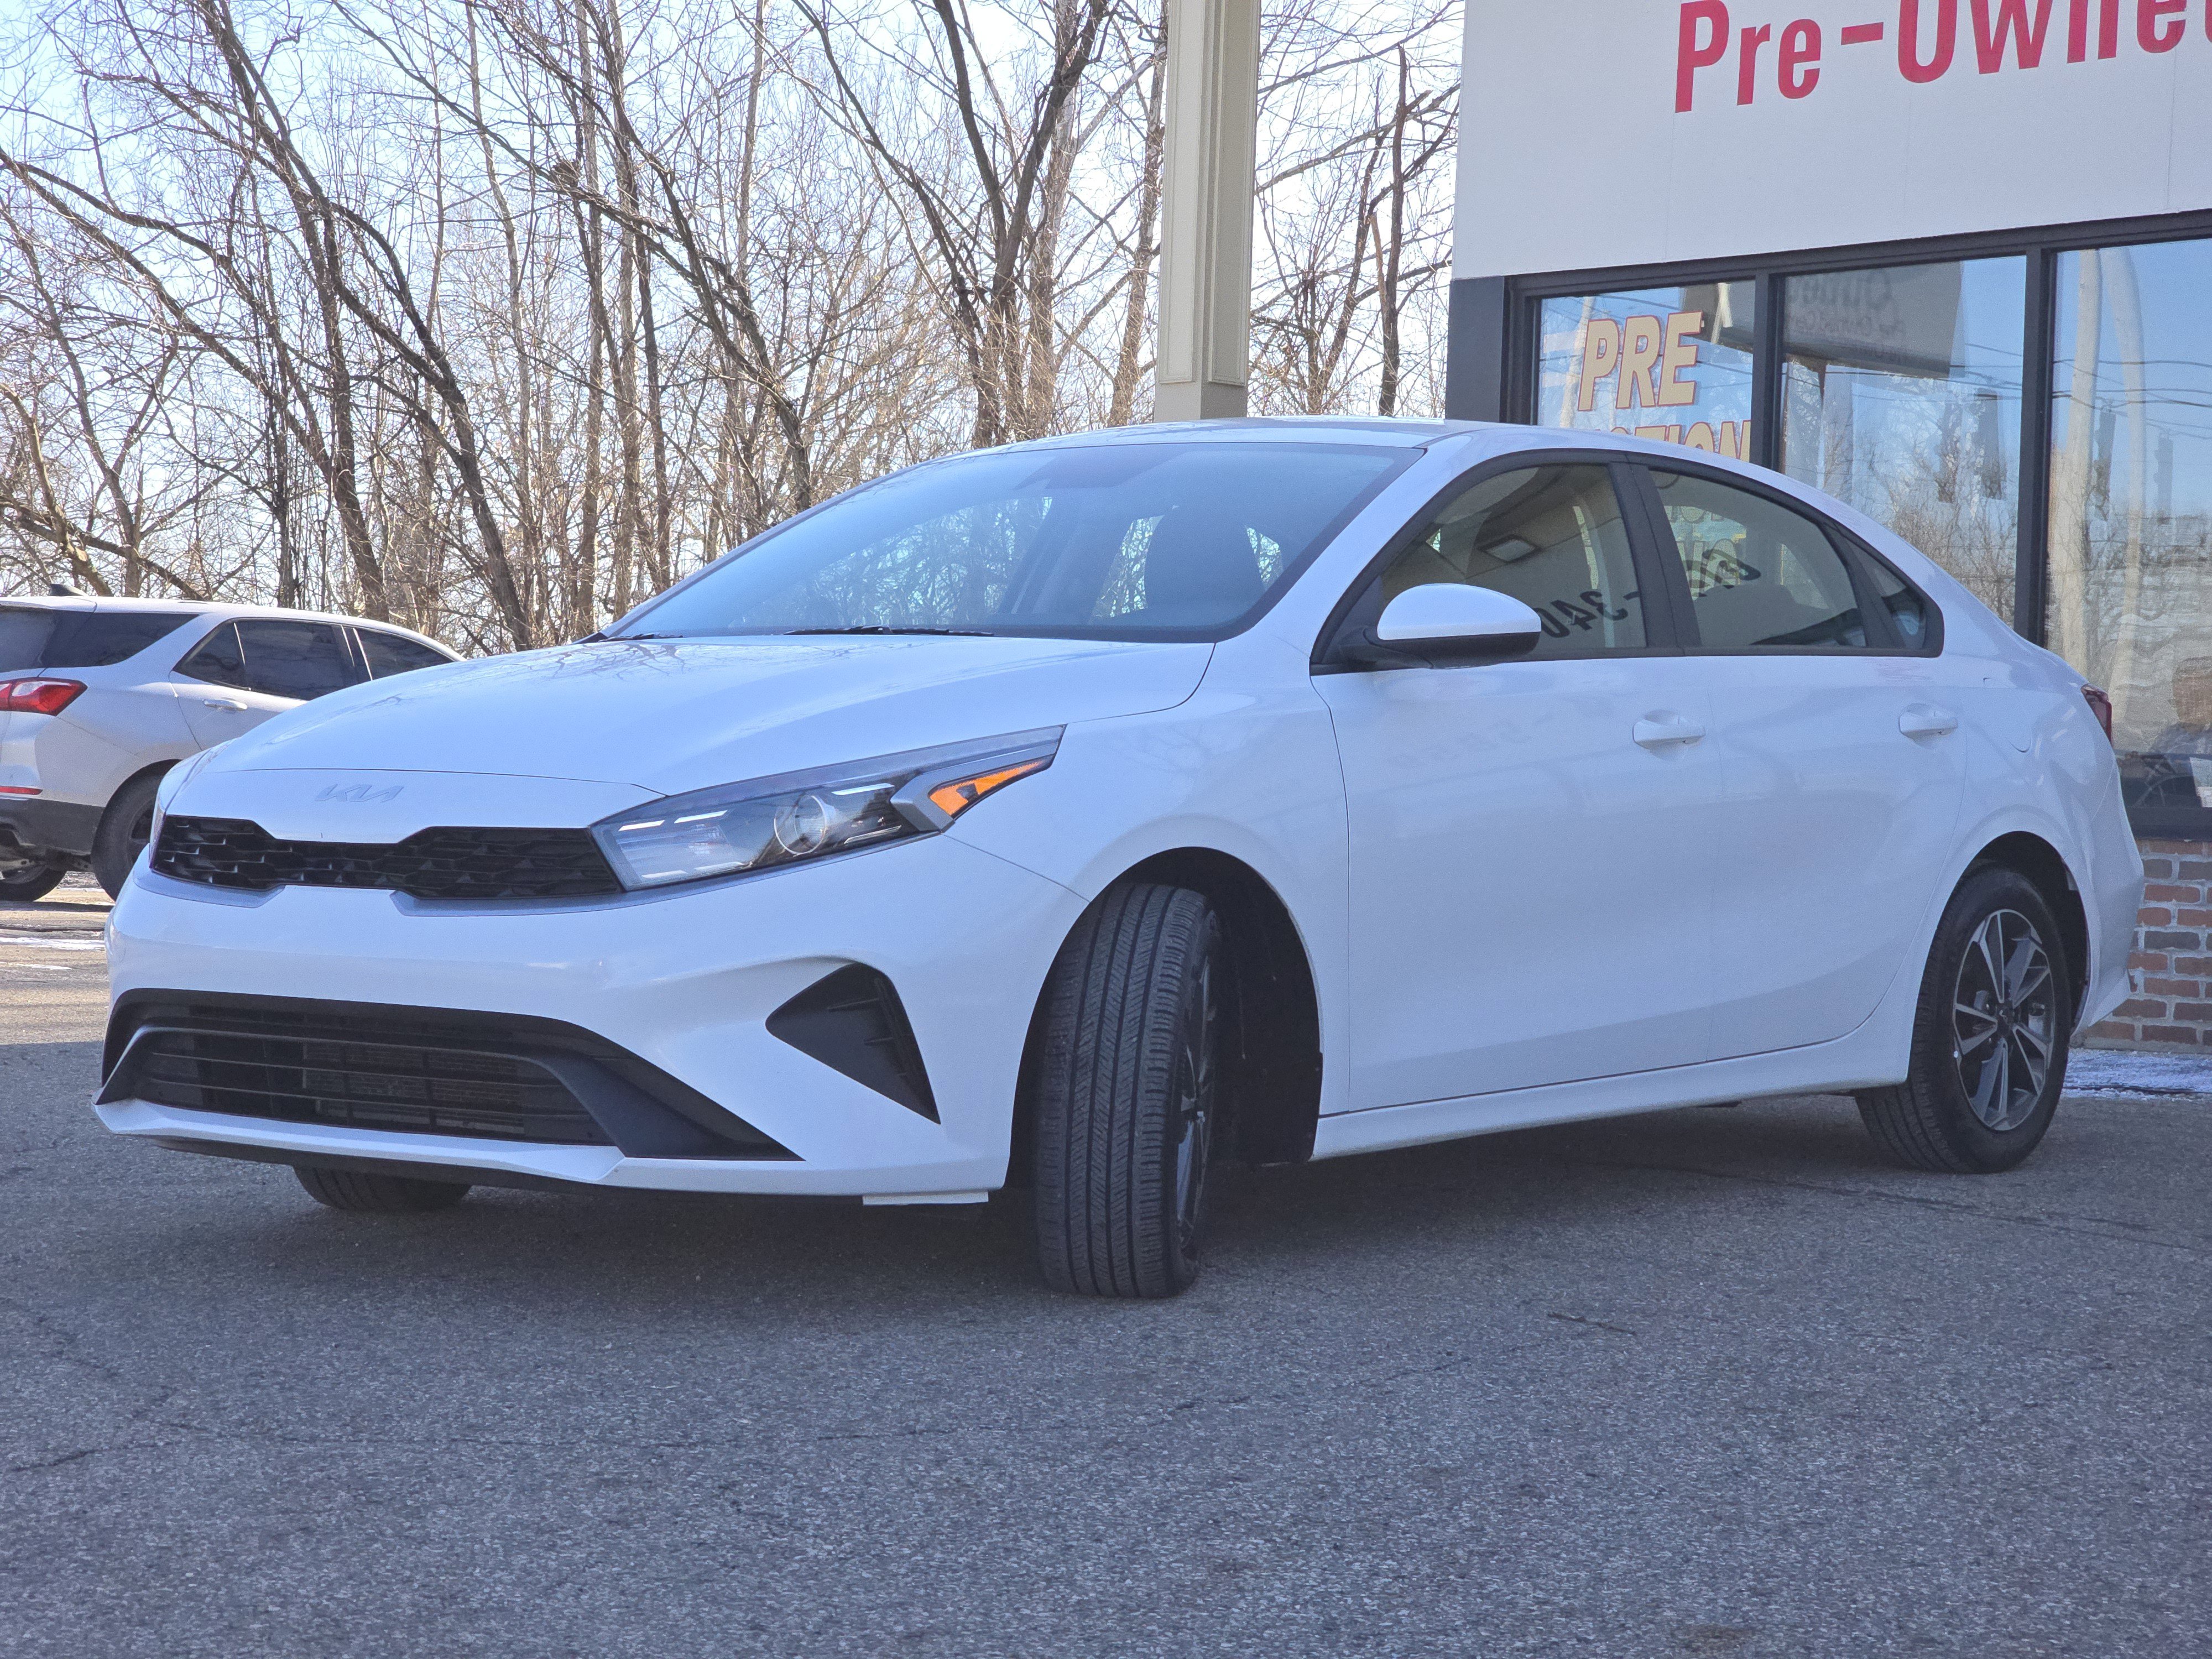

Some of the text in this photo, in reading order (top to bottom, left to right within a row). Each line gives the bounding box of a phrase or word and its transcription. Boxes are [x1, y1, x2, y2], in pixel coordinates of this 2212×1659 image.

[1674, 0, 2212, 113] Pre-Owne
[1577, 310, 1703, 412] PRE
[314, 784, 404, 803] KIA
